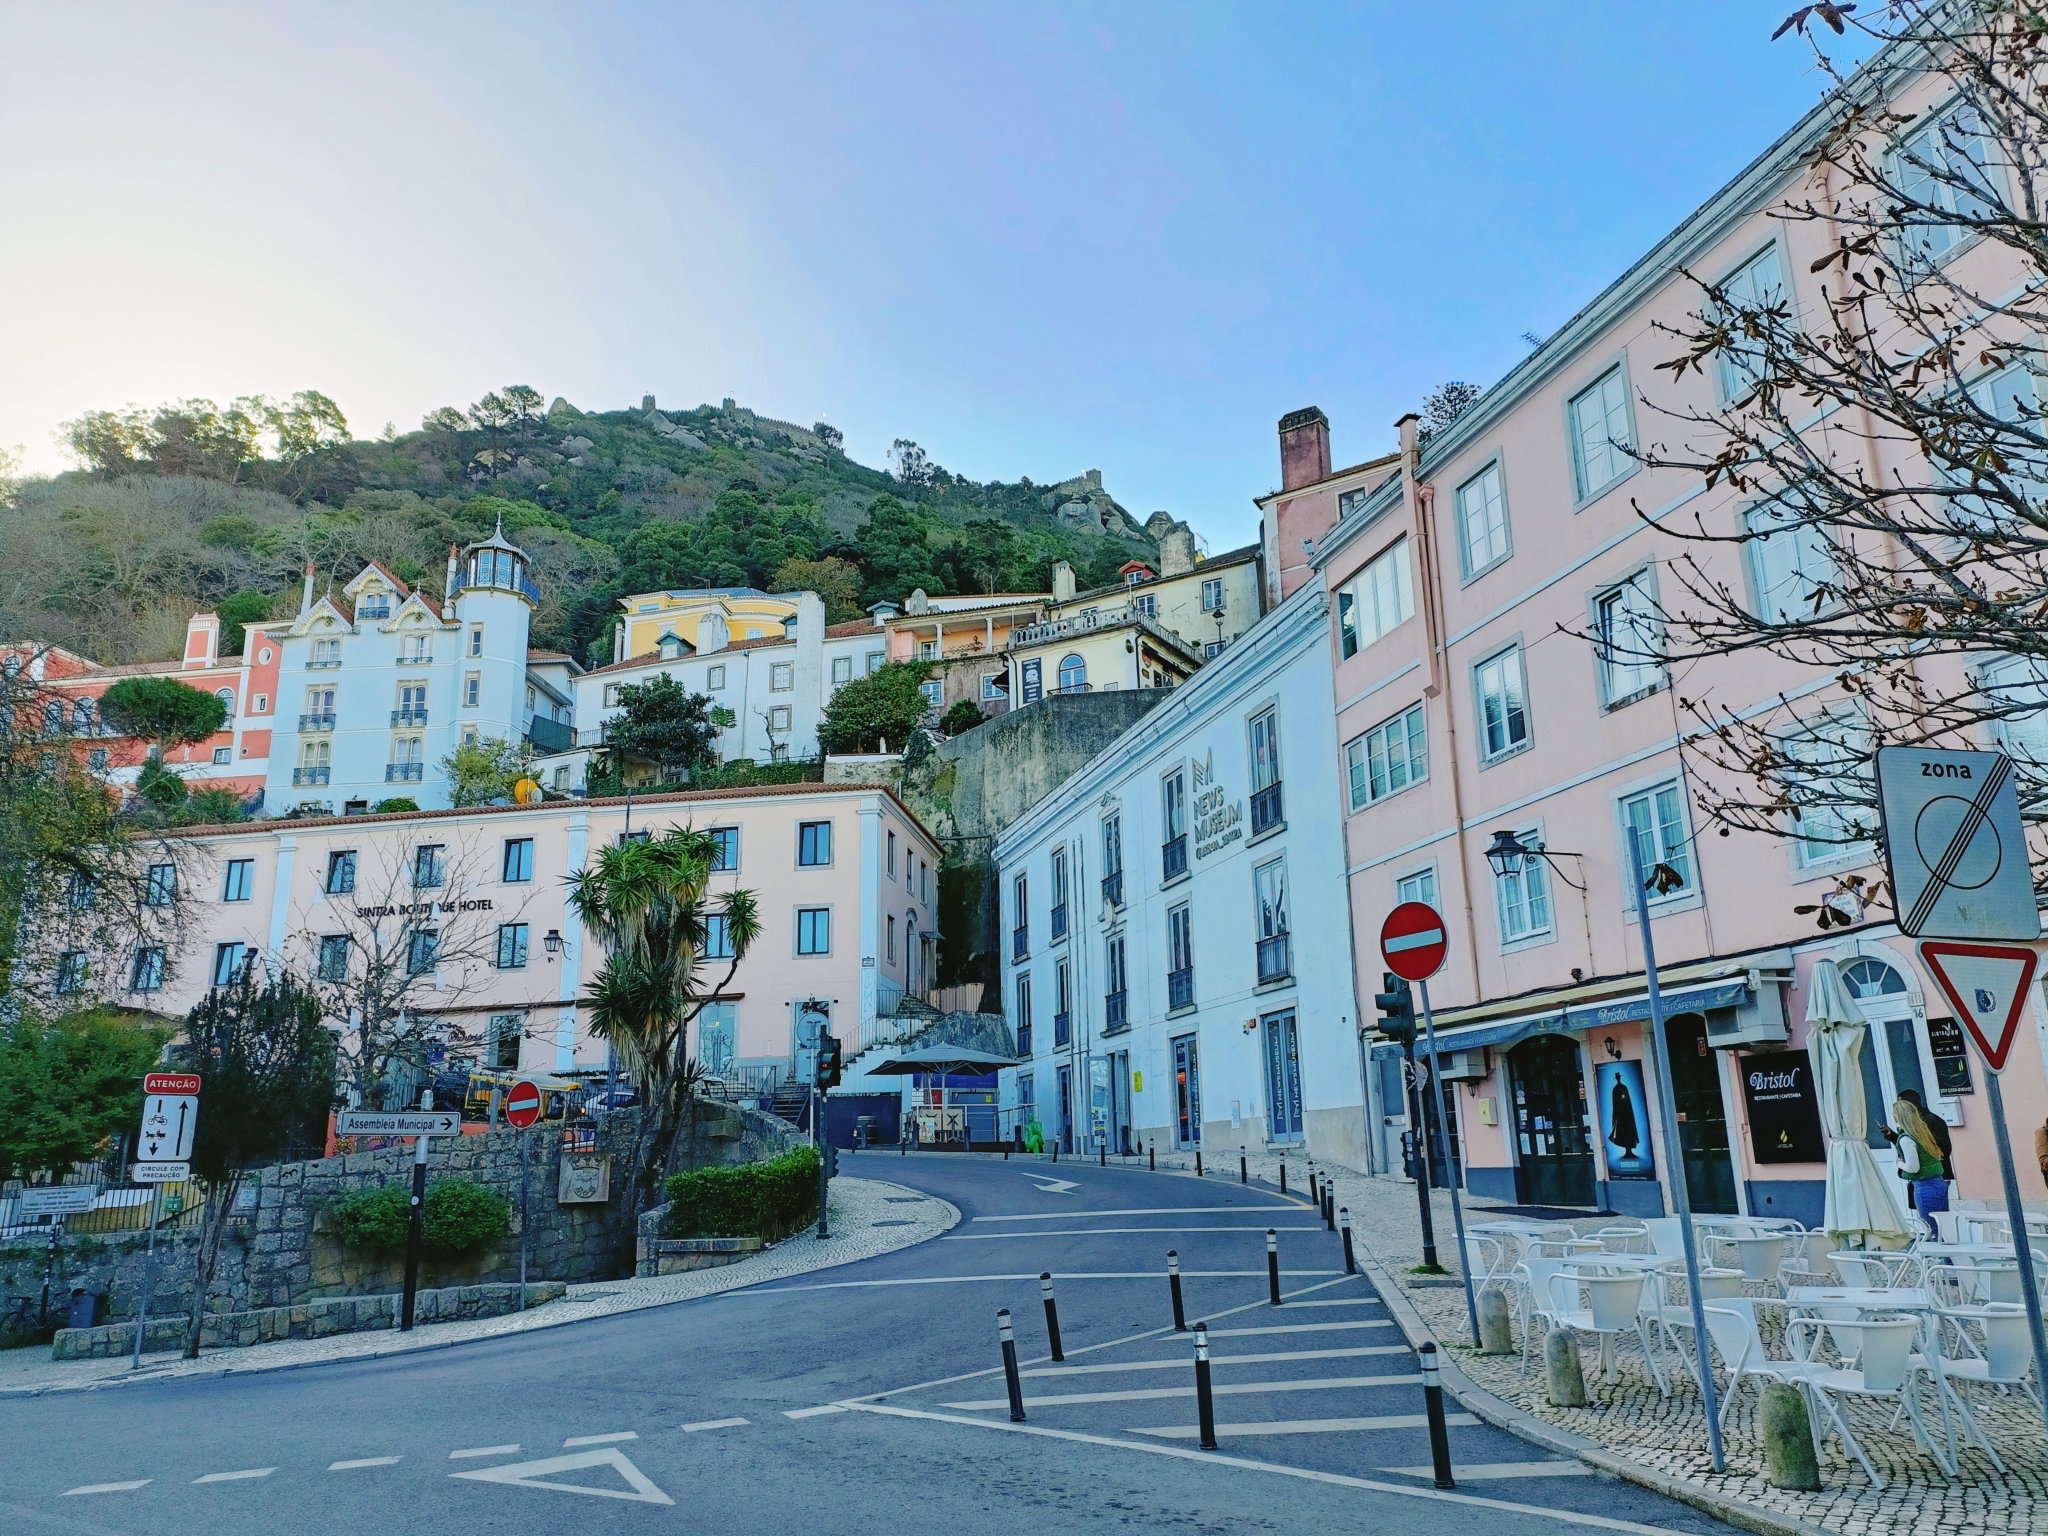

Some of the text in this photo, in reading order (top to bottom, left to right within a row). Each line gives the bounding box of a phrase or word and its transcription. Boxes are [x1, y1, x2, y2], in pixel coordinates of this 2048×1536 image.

[1921, 762, 1972, 779] zona
[1193, 785, 1224, 820] NEWS
[1194, 799, 1242, 844] MUSEUM
[357, 906, 395, 917] SINTRA
[459, 899, 493, 911] HOTEL
[1597, 1004, 1633, 1024] Bristol
[1913, 1008, 1924, 1018] 16
[149, 1079, 197, 1090] ATENÇÃO
[1750, 1067, 1800, 1090] Bristol
[348, 1118, 436, 1132] Assembleia Municipal
